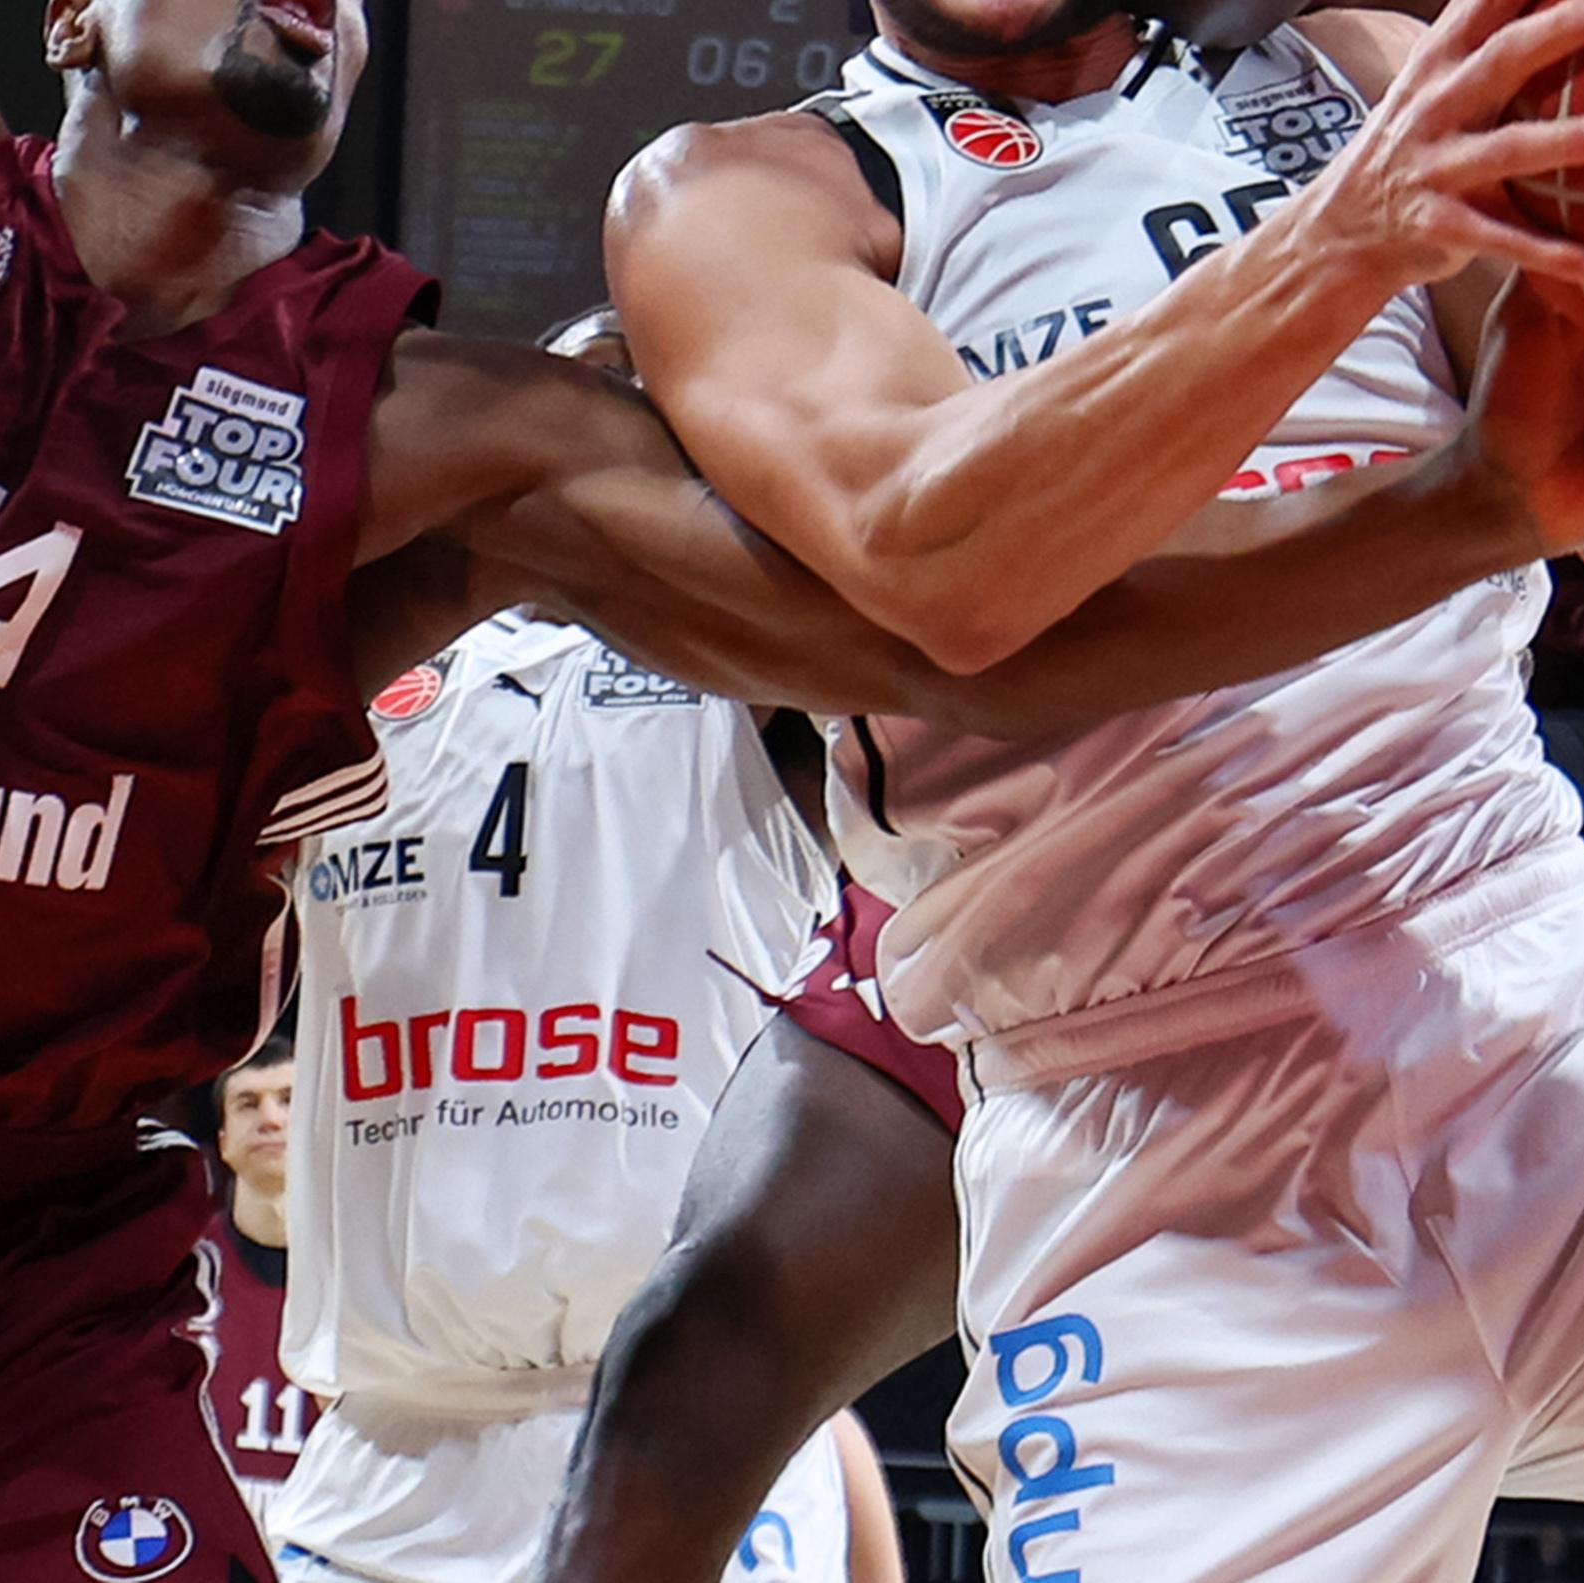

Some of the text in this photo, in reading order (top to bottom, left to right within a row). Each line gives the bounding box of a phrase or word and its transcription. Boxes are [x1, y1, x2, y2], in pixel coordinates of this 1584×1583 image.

[528, 27, 626, 86] 27
[1230, 98, 1347, 144] TOP
[205, 378, 290, 416] siegmund
[181, 402, 293, 461] TOP
[142, 437, 294, 507] FOUR
[467, 760, 533, 899] 4
[339, 994, 679, 1103] brose
[436, 1099, 485, 1127] für
[496, 1098, 680, 1130] Automobile
[235, 1376, 305, 1455] 11
